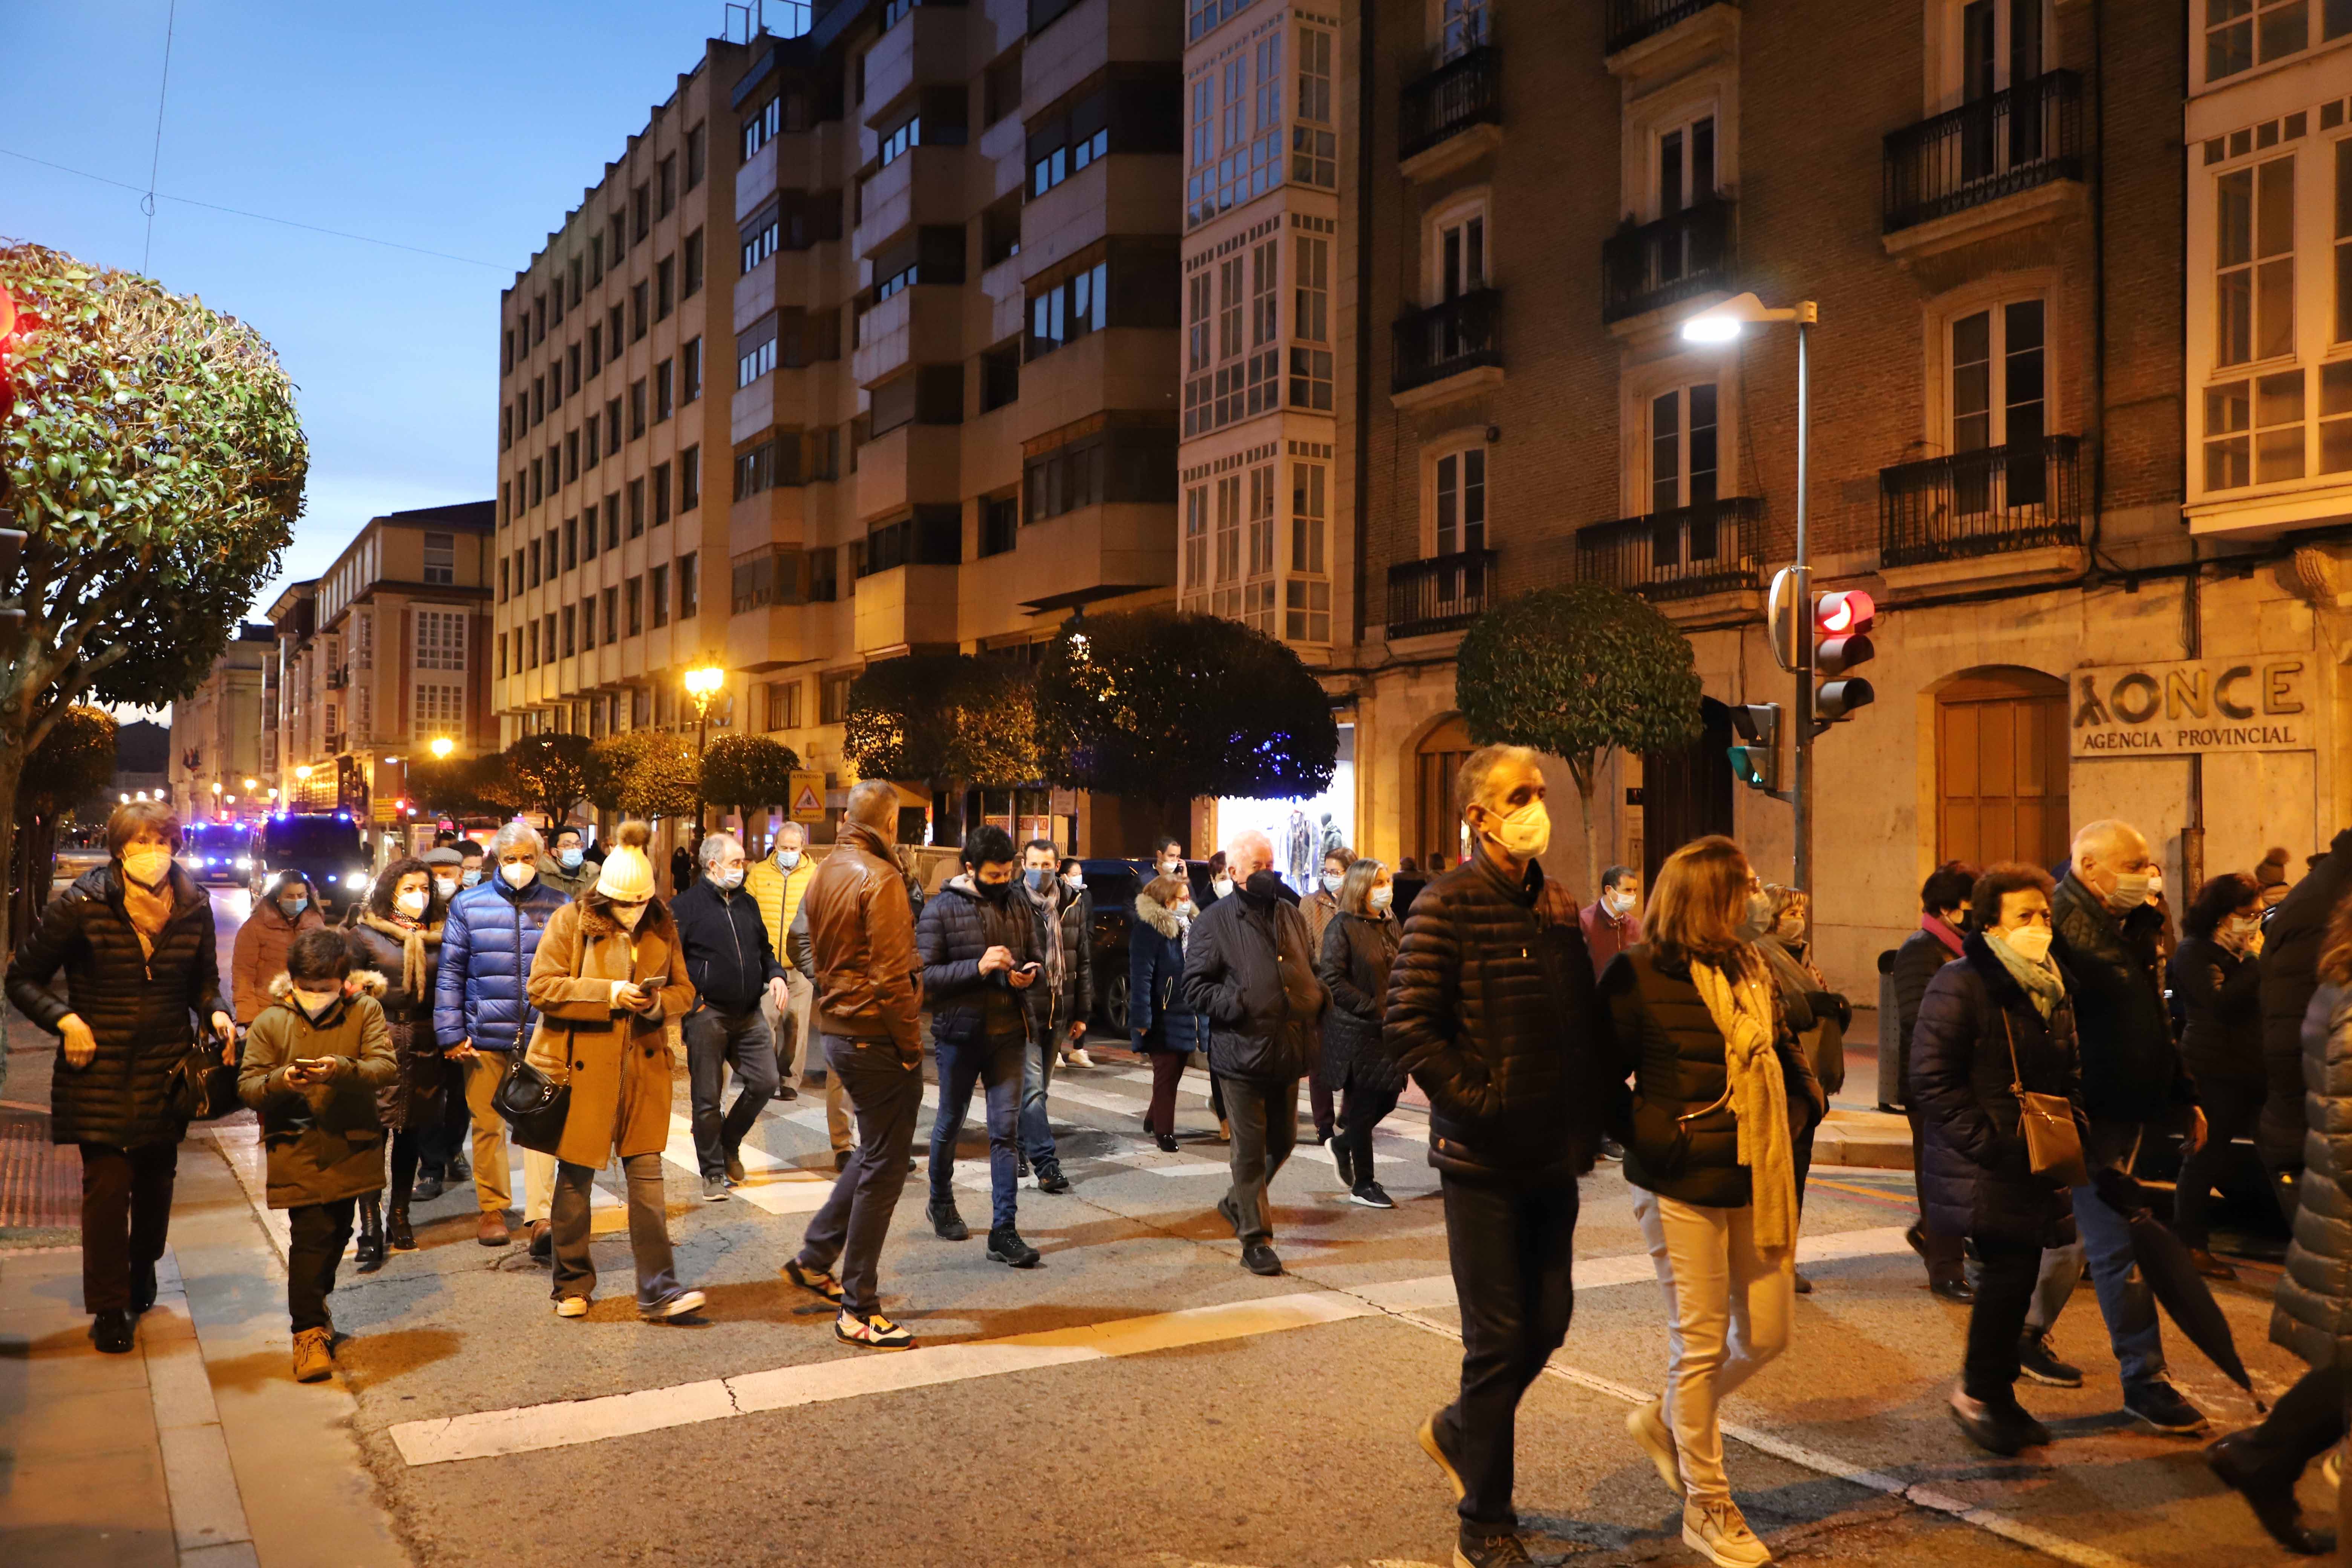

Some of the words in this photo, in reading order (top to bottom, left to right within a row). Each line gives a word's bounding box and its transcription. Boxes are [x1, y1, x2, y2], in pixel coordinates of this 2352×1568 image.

[2112, 662, 2303, 723] ONCE
[2083, 731, 2162, 749] AGENCIA
[2177, 726, 2296, 747] PROVINCIAL
